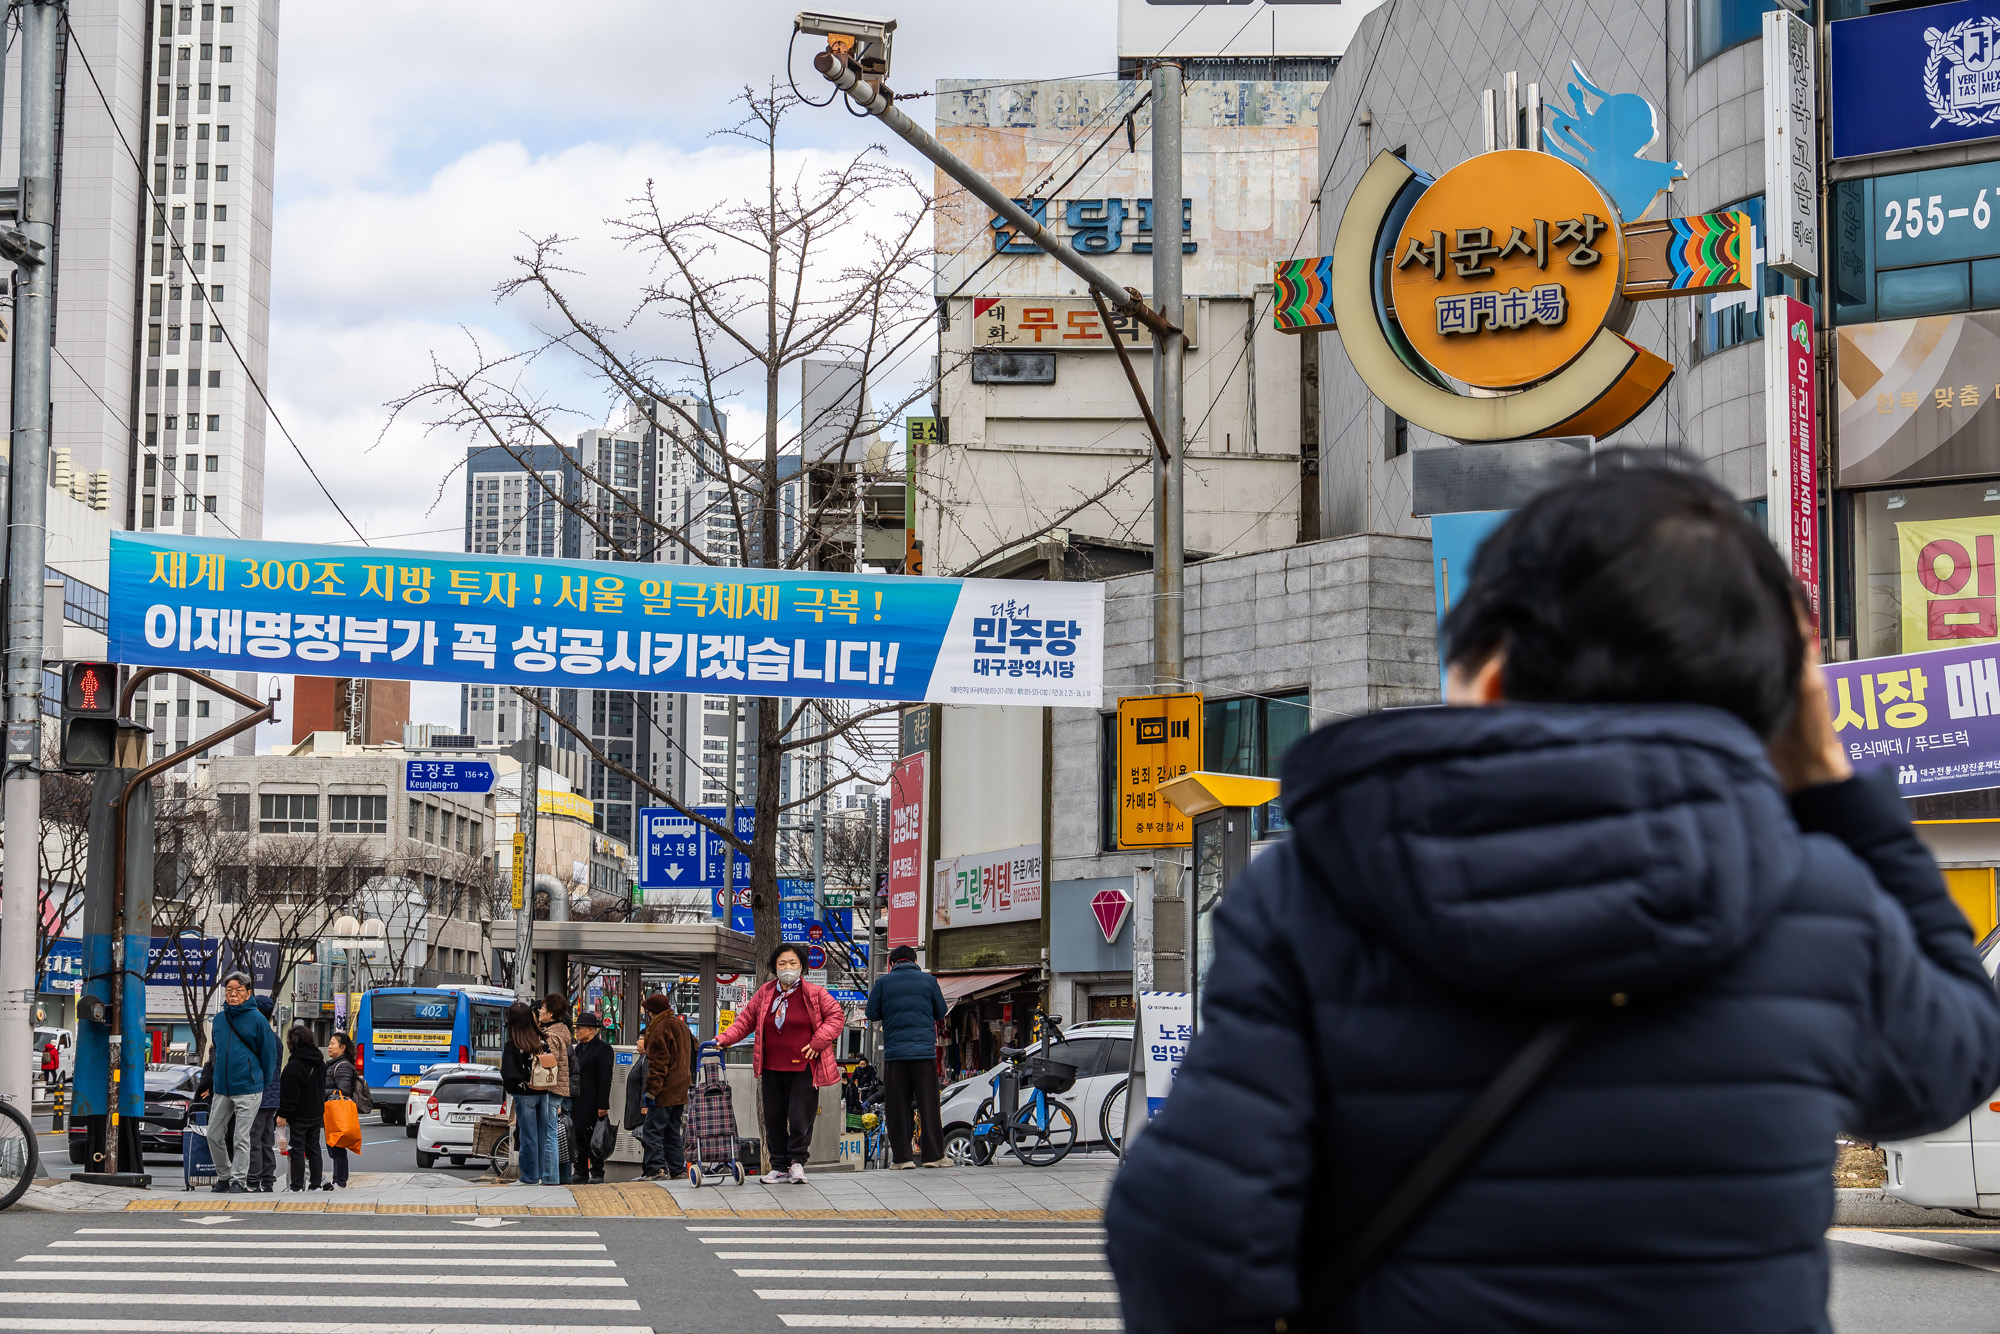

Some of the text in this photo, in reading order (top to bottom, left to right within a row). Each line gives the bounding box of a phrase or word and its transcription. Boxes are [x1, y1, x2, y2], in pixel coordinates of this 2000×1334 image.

[1957, 73, 1977, 86] VERI
[1958, 85, 1976, 97] TAS
[1885, 187, 2000, 241] 255-6
[1396, 212, 1608, 281] 서문시장
[1437, 288, 1562, 332] 西門市場
[1018, 306, 1150, 342] 무도학
[1875, 389, 1920, 414] 한복
[1934, 384, 1980, 410] 맞춤
[149, 551, 225, 592] 재계
[240, 558, 347, 597] 300조
[360, 564, 435, 605] 지방
[448, 570, 520, 609] 투자
[554, 576, 626, 614] 서울
[639, 577, 780, 621] 일극체제
[793, 588, 860, 626] 극복
[1917, 534, 1997, 640] 임
[989, 599, 1030, 621] 더불어
[144, 604, 901, 686] 이재명정부가 꼭 성공시키겠습니다!
[972, 617, 1082, 657] 민주당
[973, 658, 1076, 679] 대구광역시당
[1825, 667, 1928, 732] 시장
[1850, 737, 1903, 760] 음식매대
[1915, 729, 1970, 752] 푸드트럭
[410, 763, 455, 779] 큰장로
[1131, 765, 1151, 785] 범죄
[1920, 759, 2000, 777] 대구전통시장진흥재단
[410, 780, 459, 790] Keunjang-ro
[1126, 791, 1157, 810] 카메라
[738, 816, 755, 833] 09:0
[1135, 821, 1184, 833] 중부경찰서
[651, 843, 697, 856] 버스전용
[1013, 856, 1041, 880] 주문/제작
[955, 860, 1012, 913] 그린커텐
[420, 1006, 443, 1017] 402
[1159, 1023, 1191, 1041] 노점
[1151, 1045, 1186, 1062] 영업
